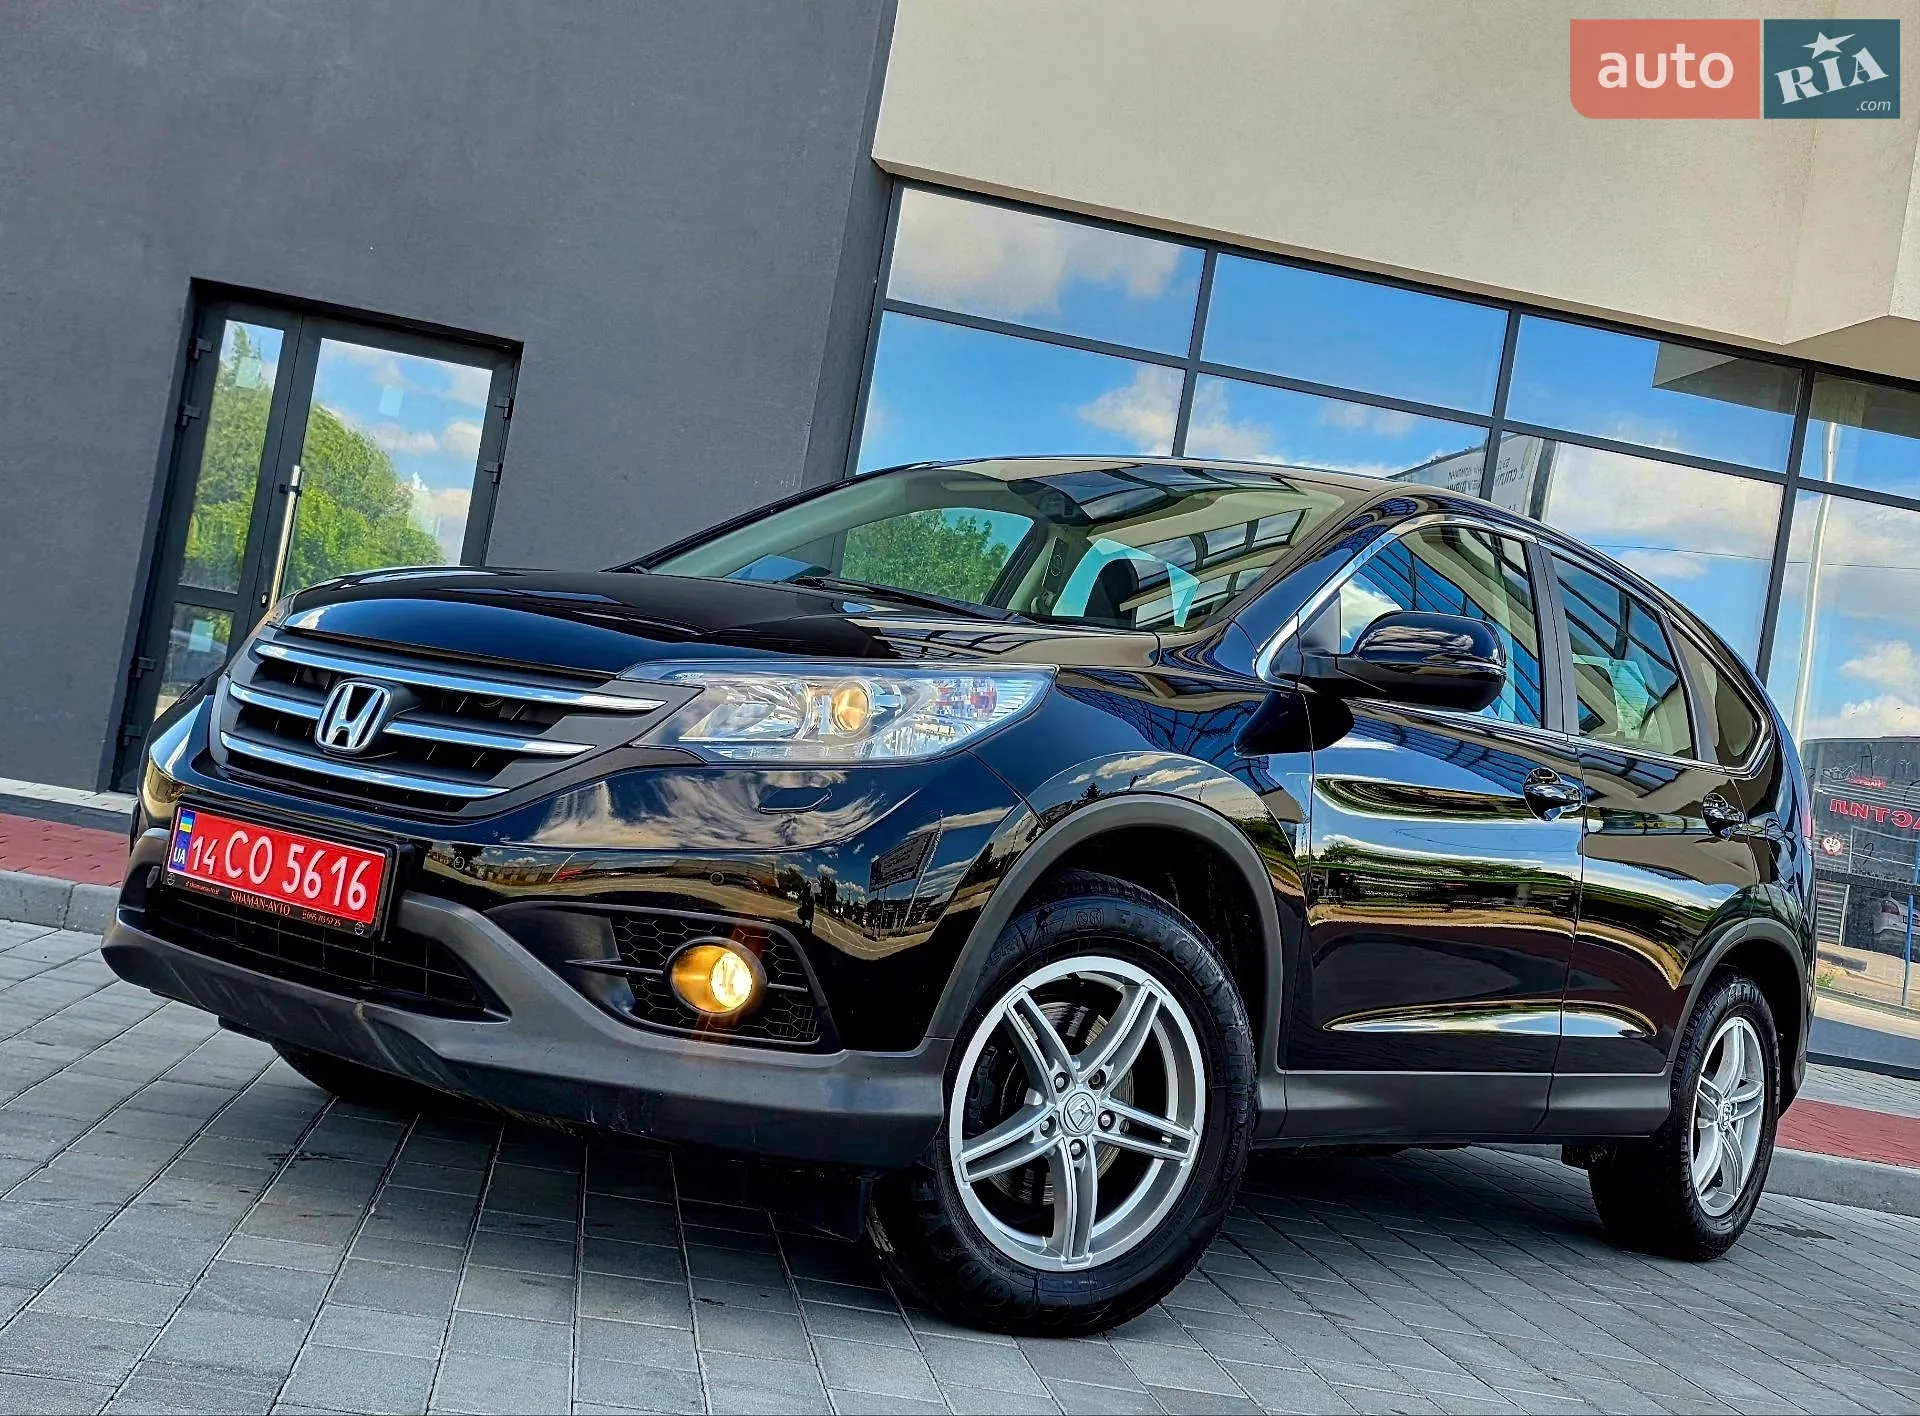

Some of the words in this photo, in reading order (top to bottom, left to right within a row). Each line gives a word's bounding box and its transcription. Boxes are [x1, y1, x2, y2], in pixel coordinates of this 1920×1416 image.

[173, 847, 186, 864] UA
[192, 835, 220, 875] 14
[224, 830, 273, 885] CO
[281, 843, 372, 911] 5616
[230, 890, 291, 916] SHAMAN-AVTO
